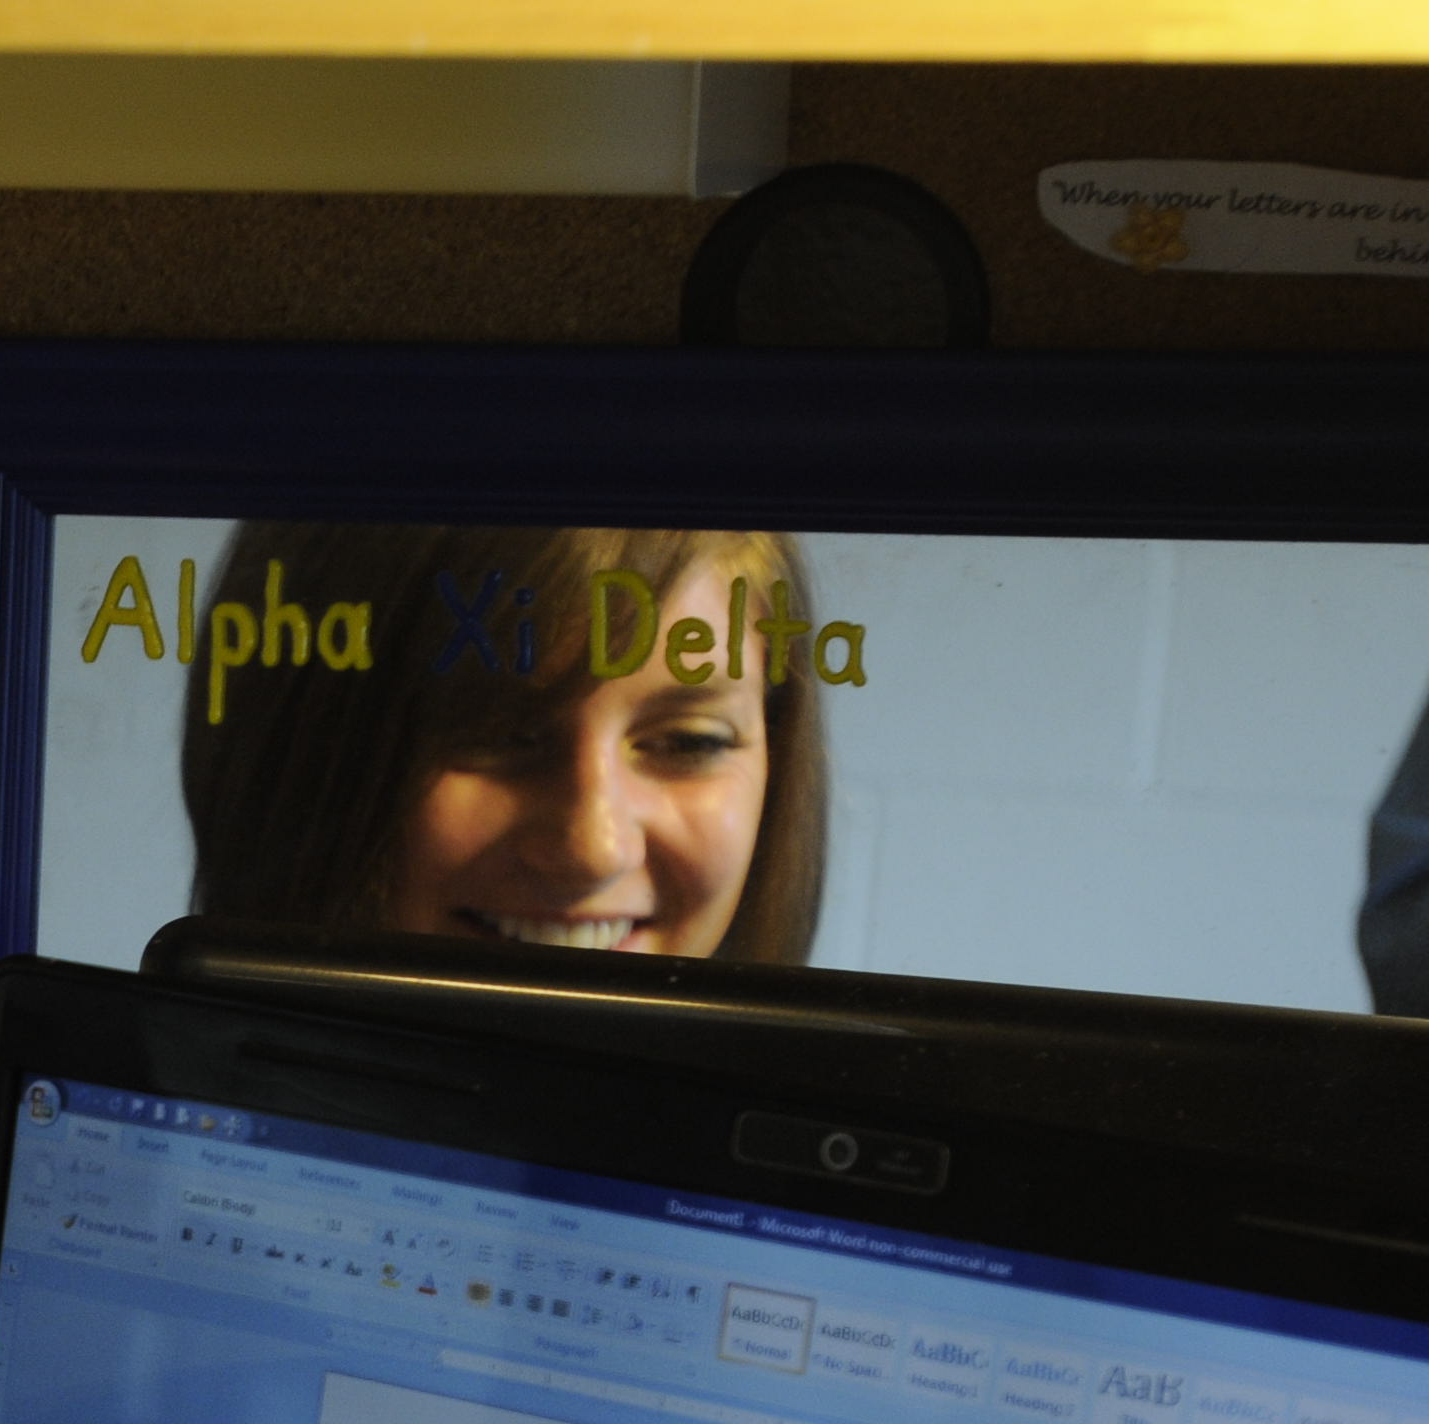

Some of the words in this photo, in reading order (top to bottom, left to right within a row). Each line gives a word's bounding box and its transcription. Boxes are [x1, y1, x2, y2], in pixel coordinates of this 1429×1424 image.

[1052, 180, 1145, 207] When
[1151, 190, 1223, 214] your
[1228, 187, 1324, 220] letters
[1329, 201, 1386, 221] are
[1390, 199, 1429, 223] in
[81, 554, 373, 725] Alpha
[430, 568, 536, 675] Xi
[587, 568, 869, 688] Delta
[758, 1215, 829, 1241] Microsoft
[828, 1228, 868, 1250] Word
